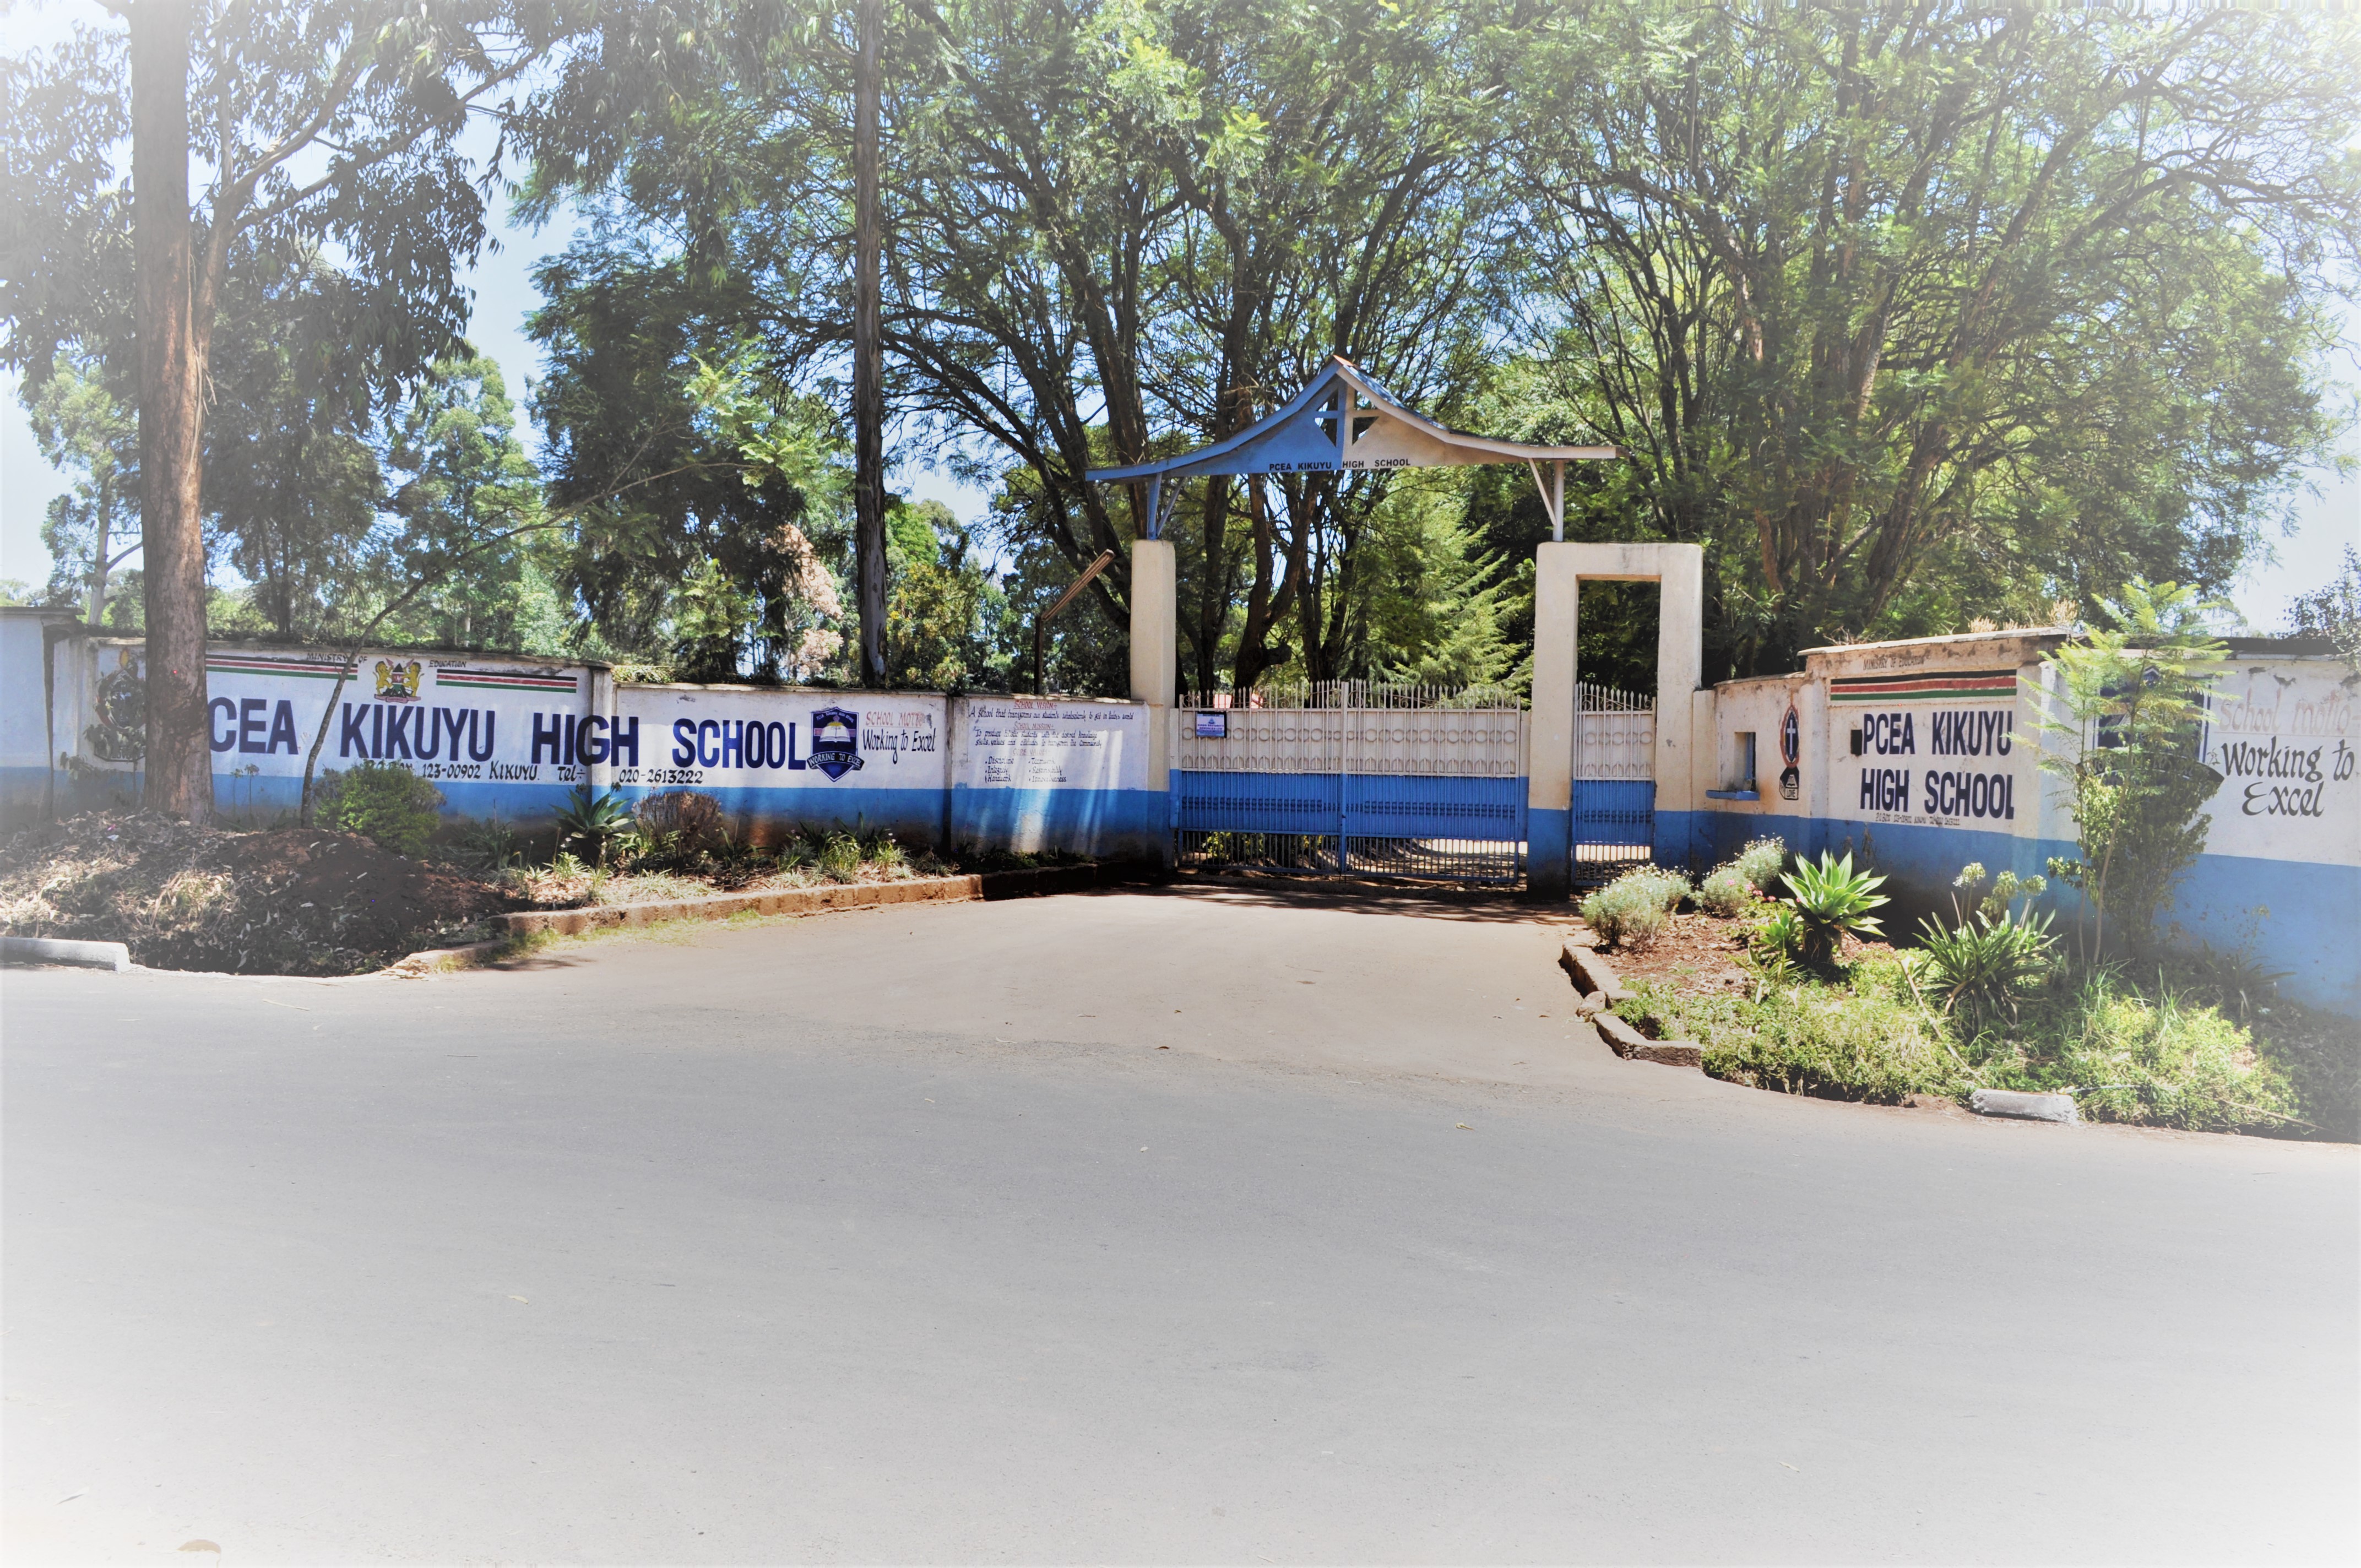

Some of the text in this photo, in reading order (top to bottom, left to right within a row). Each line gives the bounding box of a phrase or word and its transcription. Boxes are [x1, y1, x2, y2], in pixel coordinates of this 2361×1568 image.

[1269, 463, 1291, 471] PCEA
[1298, 462, 1332, 470] KIKUYU
[1375, 459, 1411, 467] SCHOOL
[306, 653, 350, 662] MINISTRY
[865, 711, 894, 725] SCHOOL
[969, 706, 976, 718] A
[1014, 700, 1033, 709] SCHOOL
[2219, 687, 2282, 733] School
[207, 697, 807, 771] CEA KIKUYU HIGH SCHOOL
[862, 727, 936, 764] Working to Excel
[1863, 710, 2013, 756] PCEA KIKUYU
[808, 752, 862, 768] WORKING TO EXCEL
[2221, 735, 2323, 783] Working
[2332, 739, 2355, 782] to
[422, 763, 481, 779] 123-00902
[618, 769, 703, 784] 020-2613222
[1860, 768, 2015, 820] HIGH SCHOOL
[2241, 781, 2325, 817] Excel
